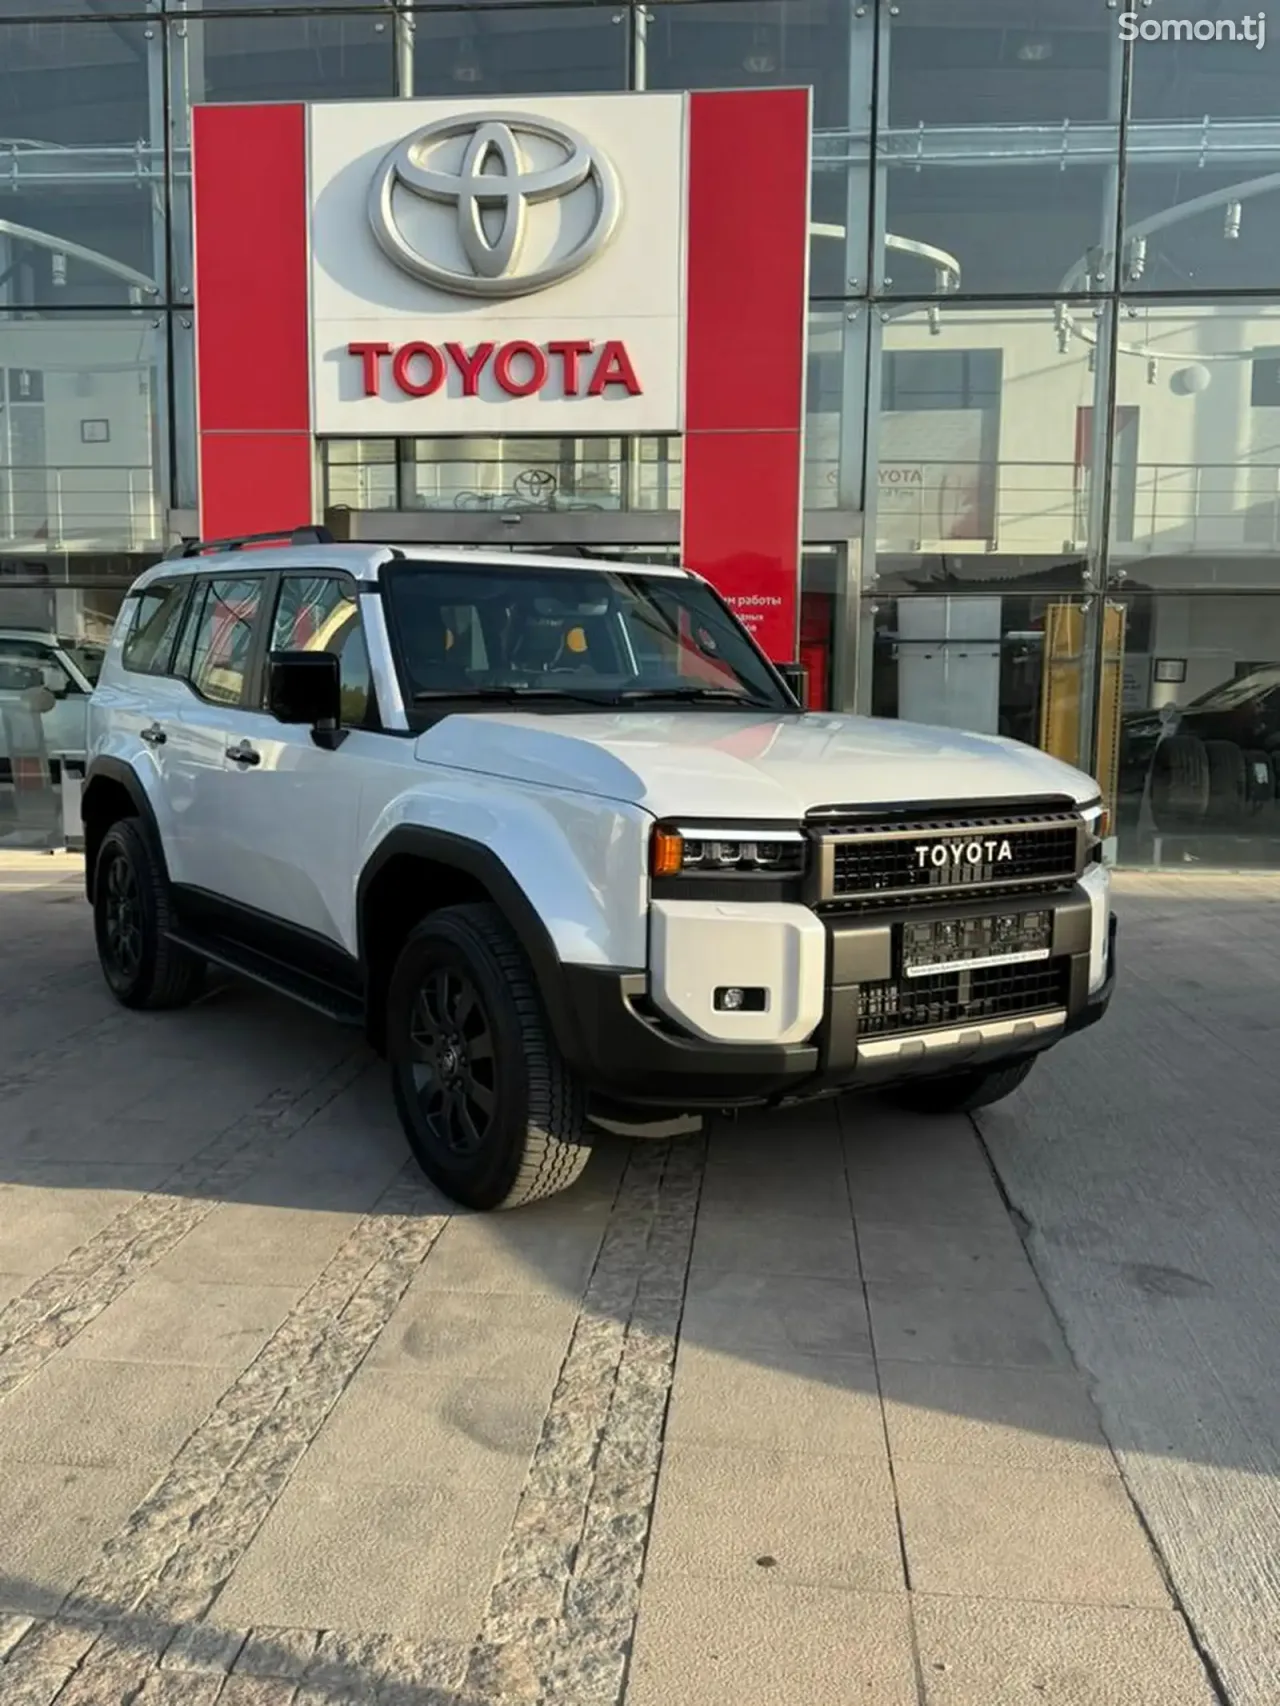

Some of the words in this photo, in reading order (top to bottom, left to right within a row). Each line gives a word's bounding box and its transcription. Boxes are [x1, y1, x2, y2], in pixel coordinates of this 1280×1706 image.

[348, 340, 643, 397] TOYOTA
[878, 469, 923, 484] YOTA
[738, 594, 782, 607] работы
[915, 840, 1012, 867] TOYOTA
